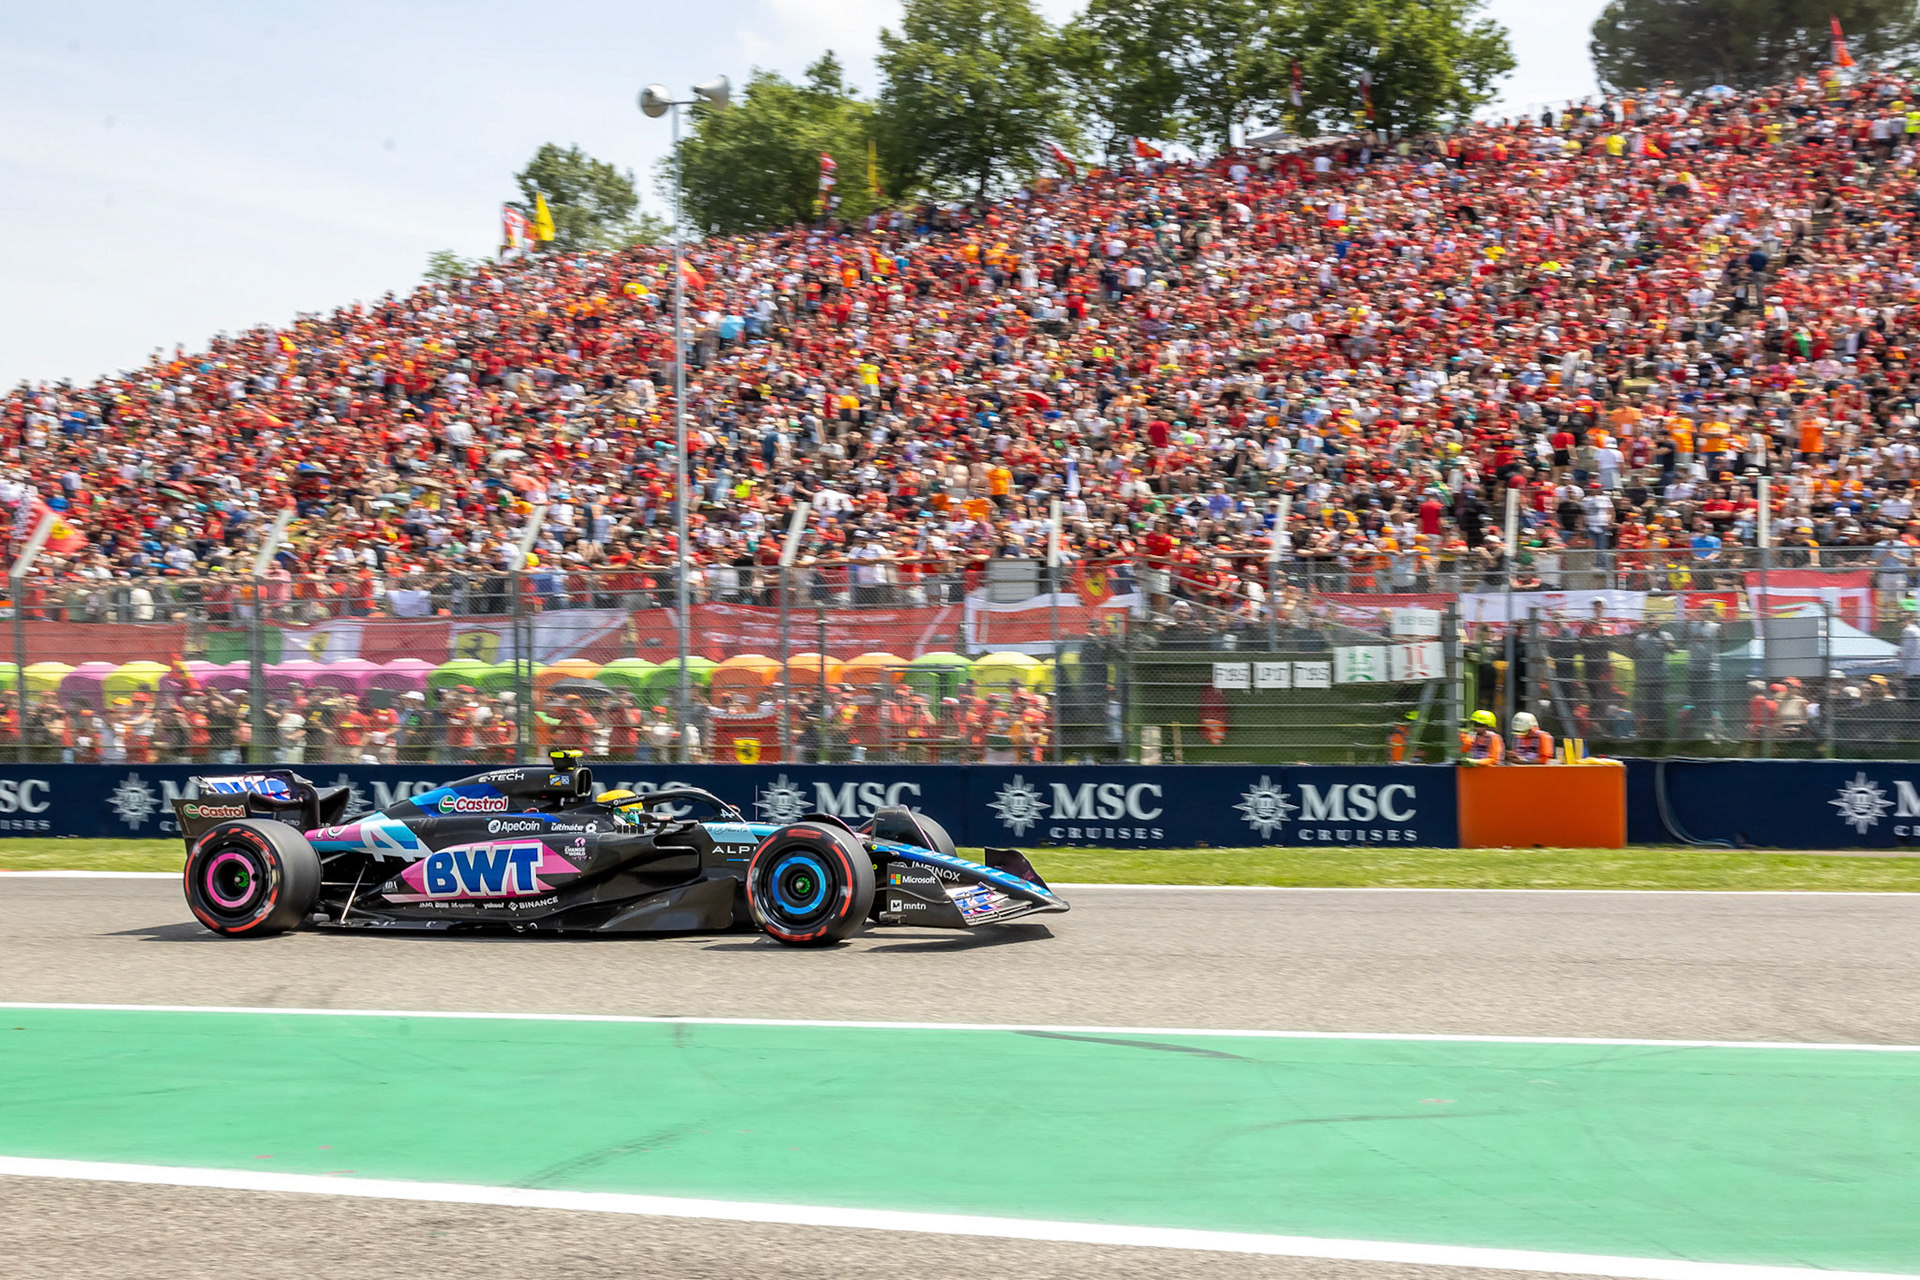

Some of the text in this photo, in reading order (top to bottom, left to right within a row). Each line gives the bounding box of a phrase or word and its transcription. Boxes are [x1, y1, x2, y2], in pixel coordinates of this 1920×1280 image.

[455, 795, 508, 812] Castrol
[812, 782, 922, 818] MSC
[1050, 783, 1162, 820] MSC
[1299, 784, 1416, 821] MSC
[199, 804, 247, 818] Castrol
[501, 820, 540, 833] ApeCoin
[1050, 827, 1163, 839] CRUISES
[1299, 829, 1417, 841] CRUISES
[424, 844, 543, 896] BWT
[902, 876, 936, 885] Microsoft
[519, 896, 559, 909] BINANCE
[903, 902, 927, 910] mntn
